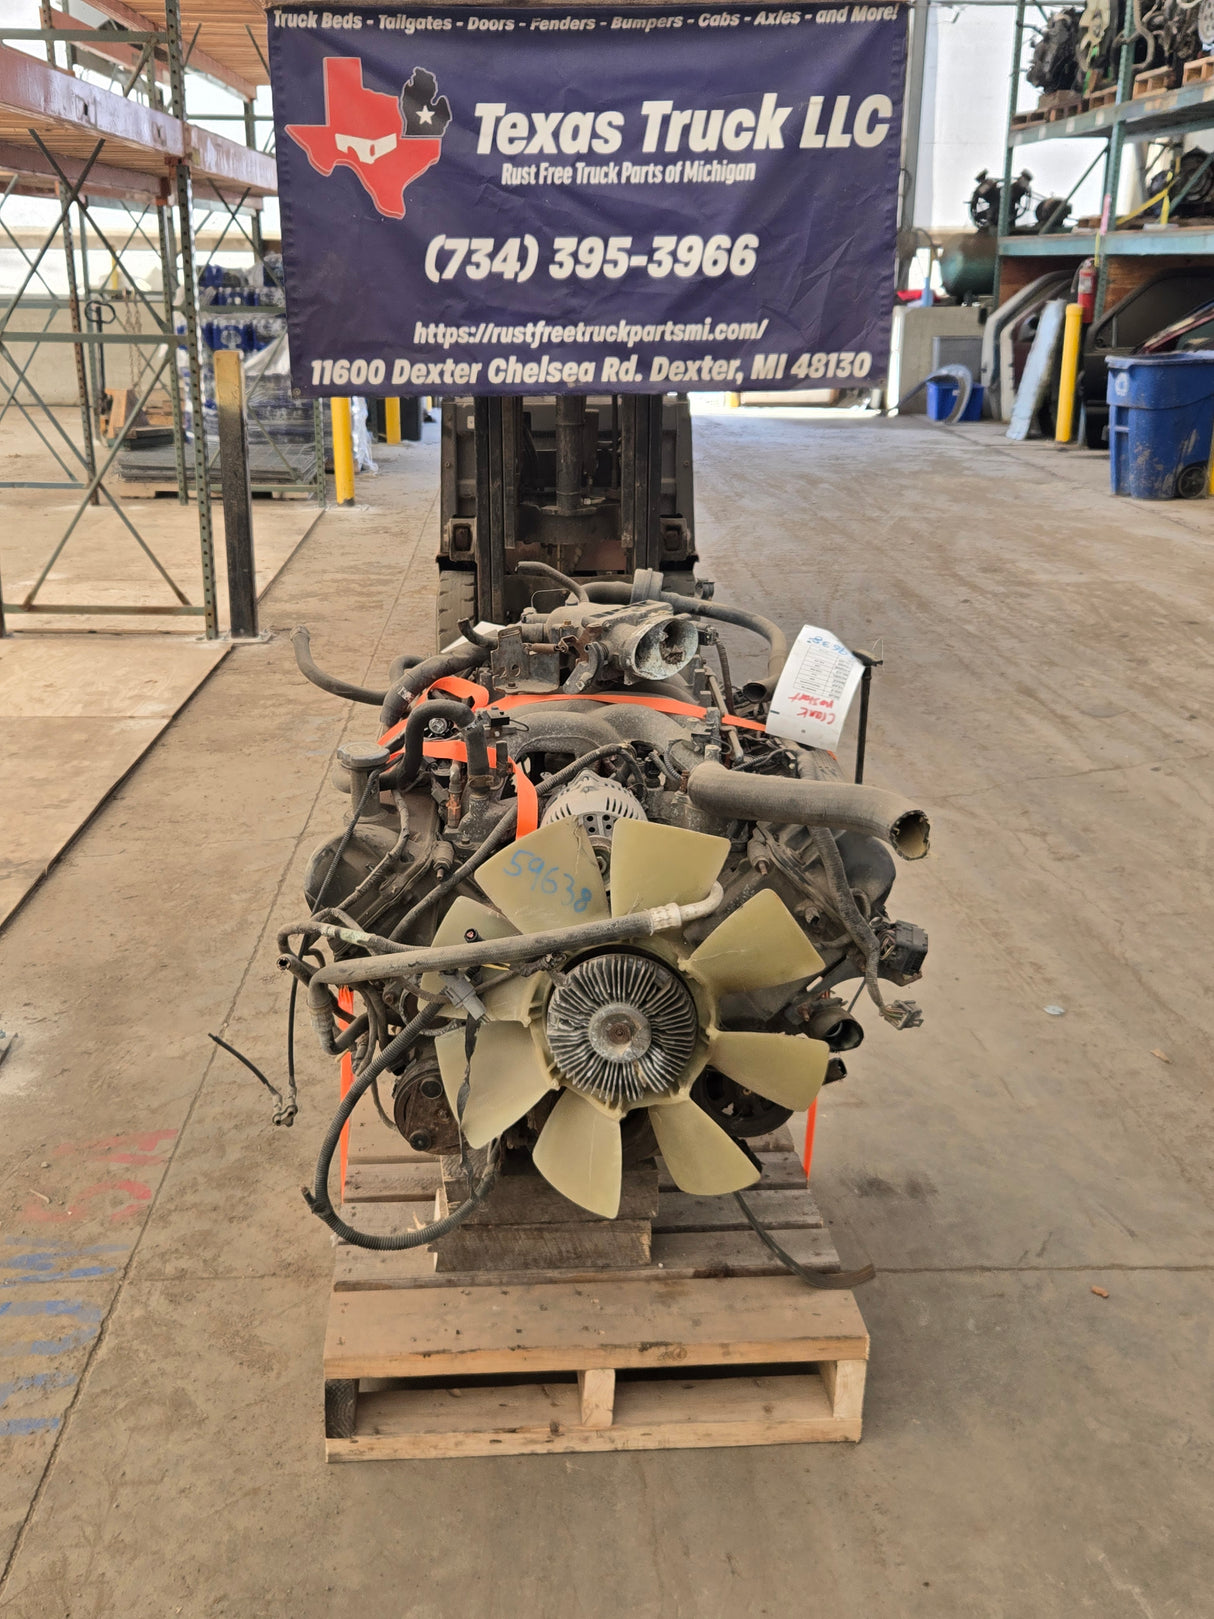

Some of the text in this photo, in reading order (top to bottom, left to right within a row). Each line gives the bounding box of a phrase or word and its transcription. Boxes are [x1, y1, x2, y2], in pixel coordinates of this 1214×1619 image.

[273, 9, 318, 29] Truck
[321, 12, 363, 29] Beds
[378, 14, 452, 35] Tailgates
[467, 17, 515, 31] Doors
[530, 16, 596, 30] Fenders
[610, 16, 683, 33] Bumpers
[698, 12, 740, 27] Cabs
[753, 9, 802, 26] Axles
[815, 6, 849, 24] and
[851, 4, 899, 22] More!
[474, 92, 893, 155] Texas Truck LLC
[501, 160, 757, 186] Rust Free Truck Parts of Michigan
[424, 233, 760, 284] (734) 395-3966
[413, 317, 770, 350] https://rustfreetruckpartsmi.com/
[311, 351, 873, 386] 11600 Dexter Chelsea Rd. Dexter, MI 48130
[503, 849, 593, 913] 59638
